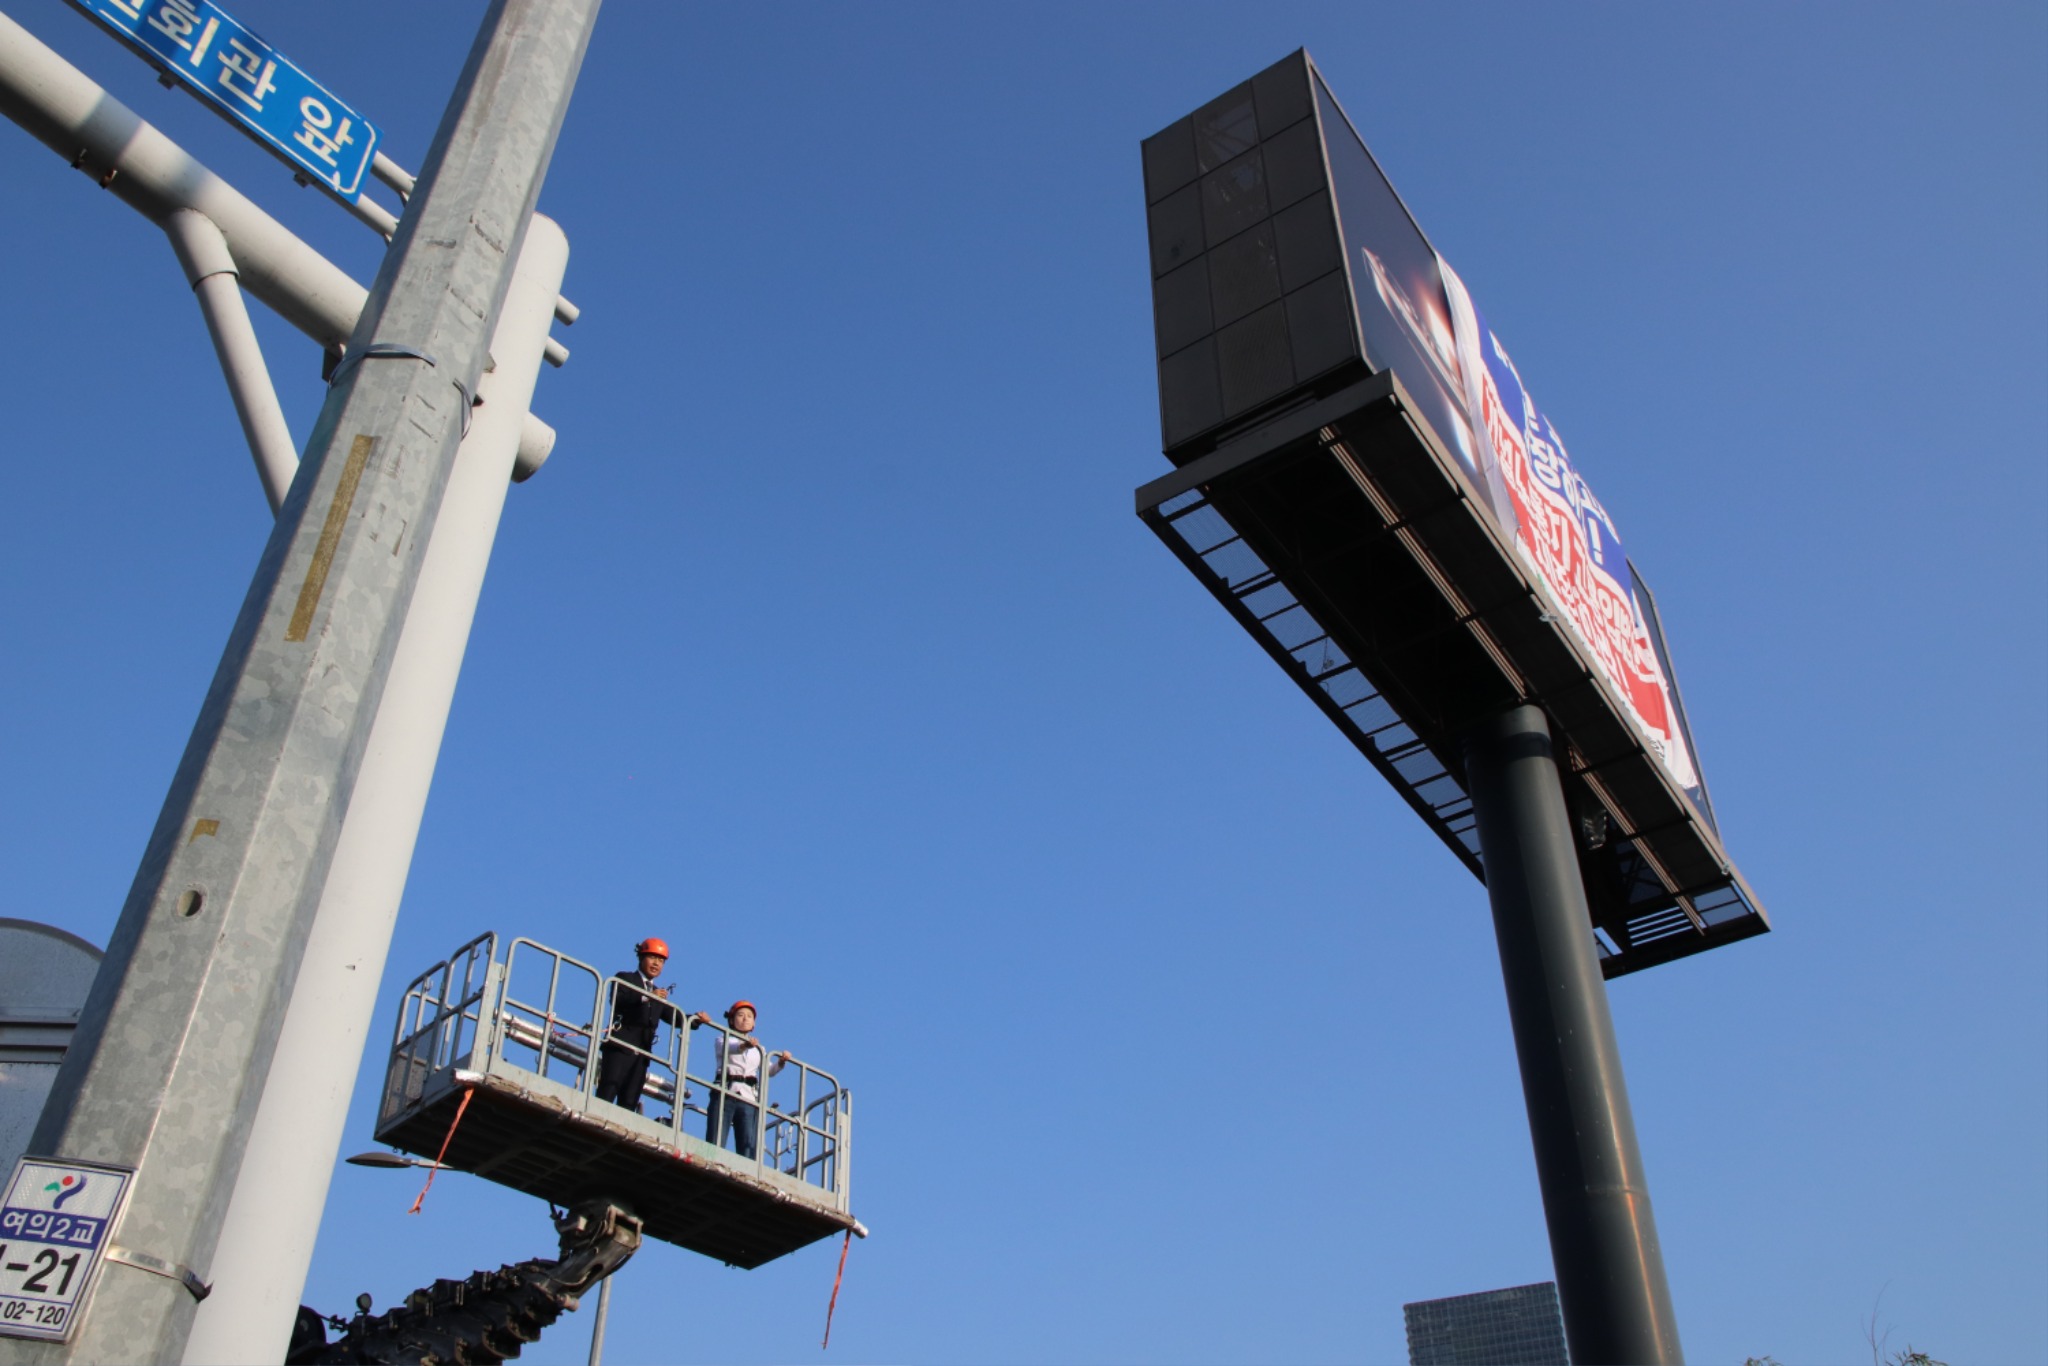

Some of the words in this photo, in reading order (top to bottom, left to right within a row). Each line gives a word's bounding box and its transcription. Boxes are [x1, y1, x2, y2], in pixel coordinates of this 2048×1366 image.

[293, 96, 354, 167] 앞
[3, 1211, 98, 1244] 여의2교
[4, 1301, 65, 1325] 02-120
